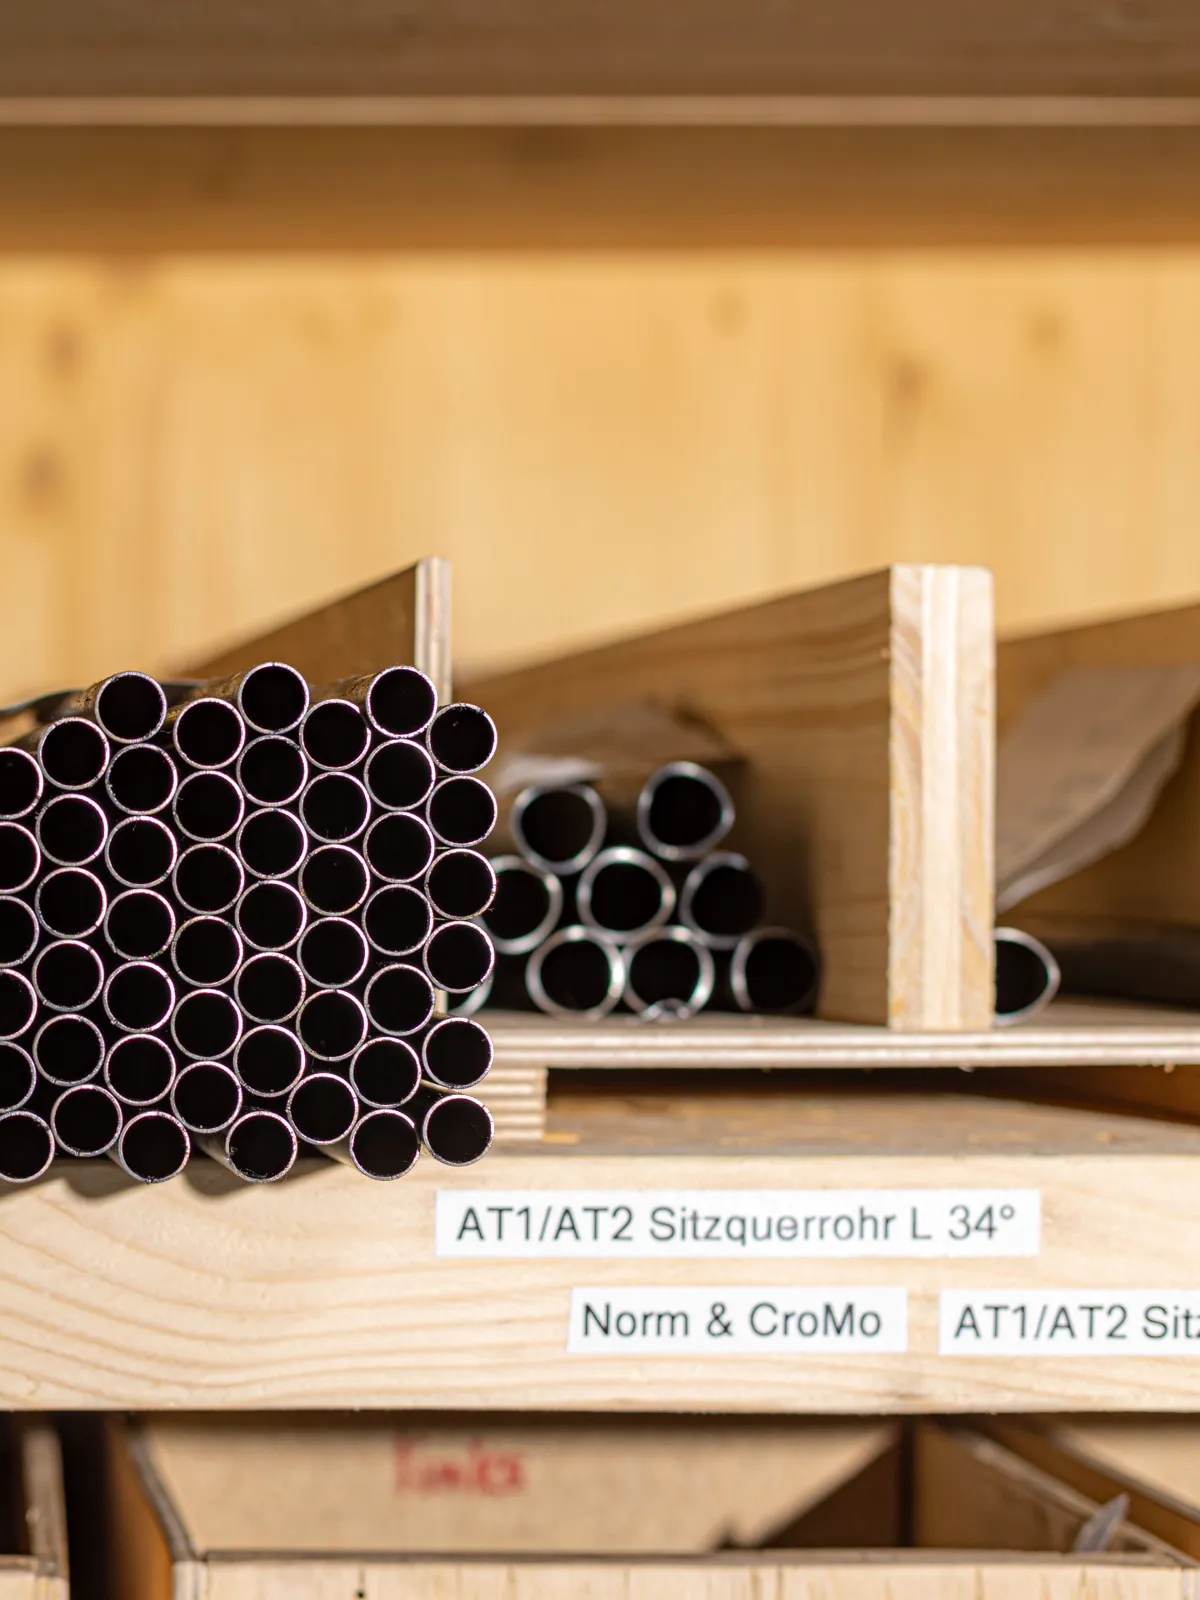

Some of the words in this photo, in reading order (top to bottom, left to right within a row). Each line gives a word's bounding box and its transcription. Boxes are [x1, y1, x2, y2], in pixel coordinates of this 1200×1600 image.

[456, 1205, 634, 1242] AT1/AT2
[649, 1205, 896, 1246] Sitzquerrohr
[911, 1205, 933, 1241] L
[948, 1204, 1017, 1240] 34°
[583, 1302, 689, 1338] Norm
[706, 1302, 733, 1338] &
[748, 1302, 882, 1338] CroMo
[954, 1304, 1128, 1339] AT1/AT2
